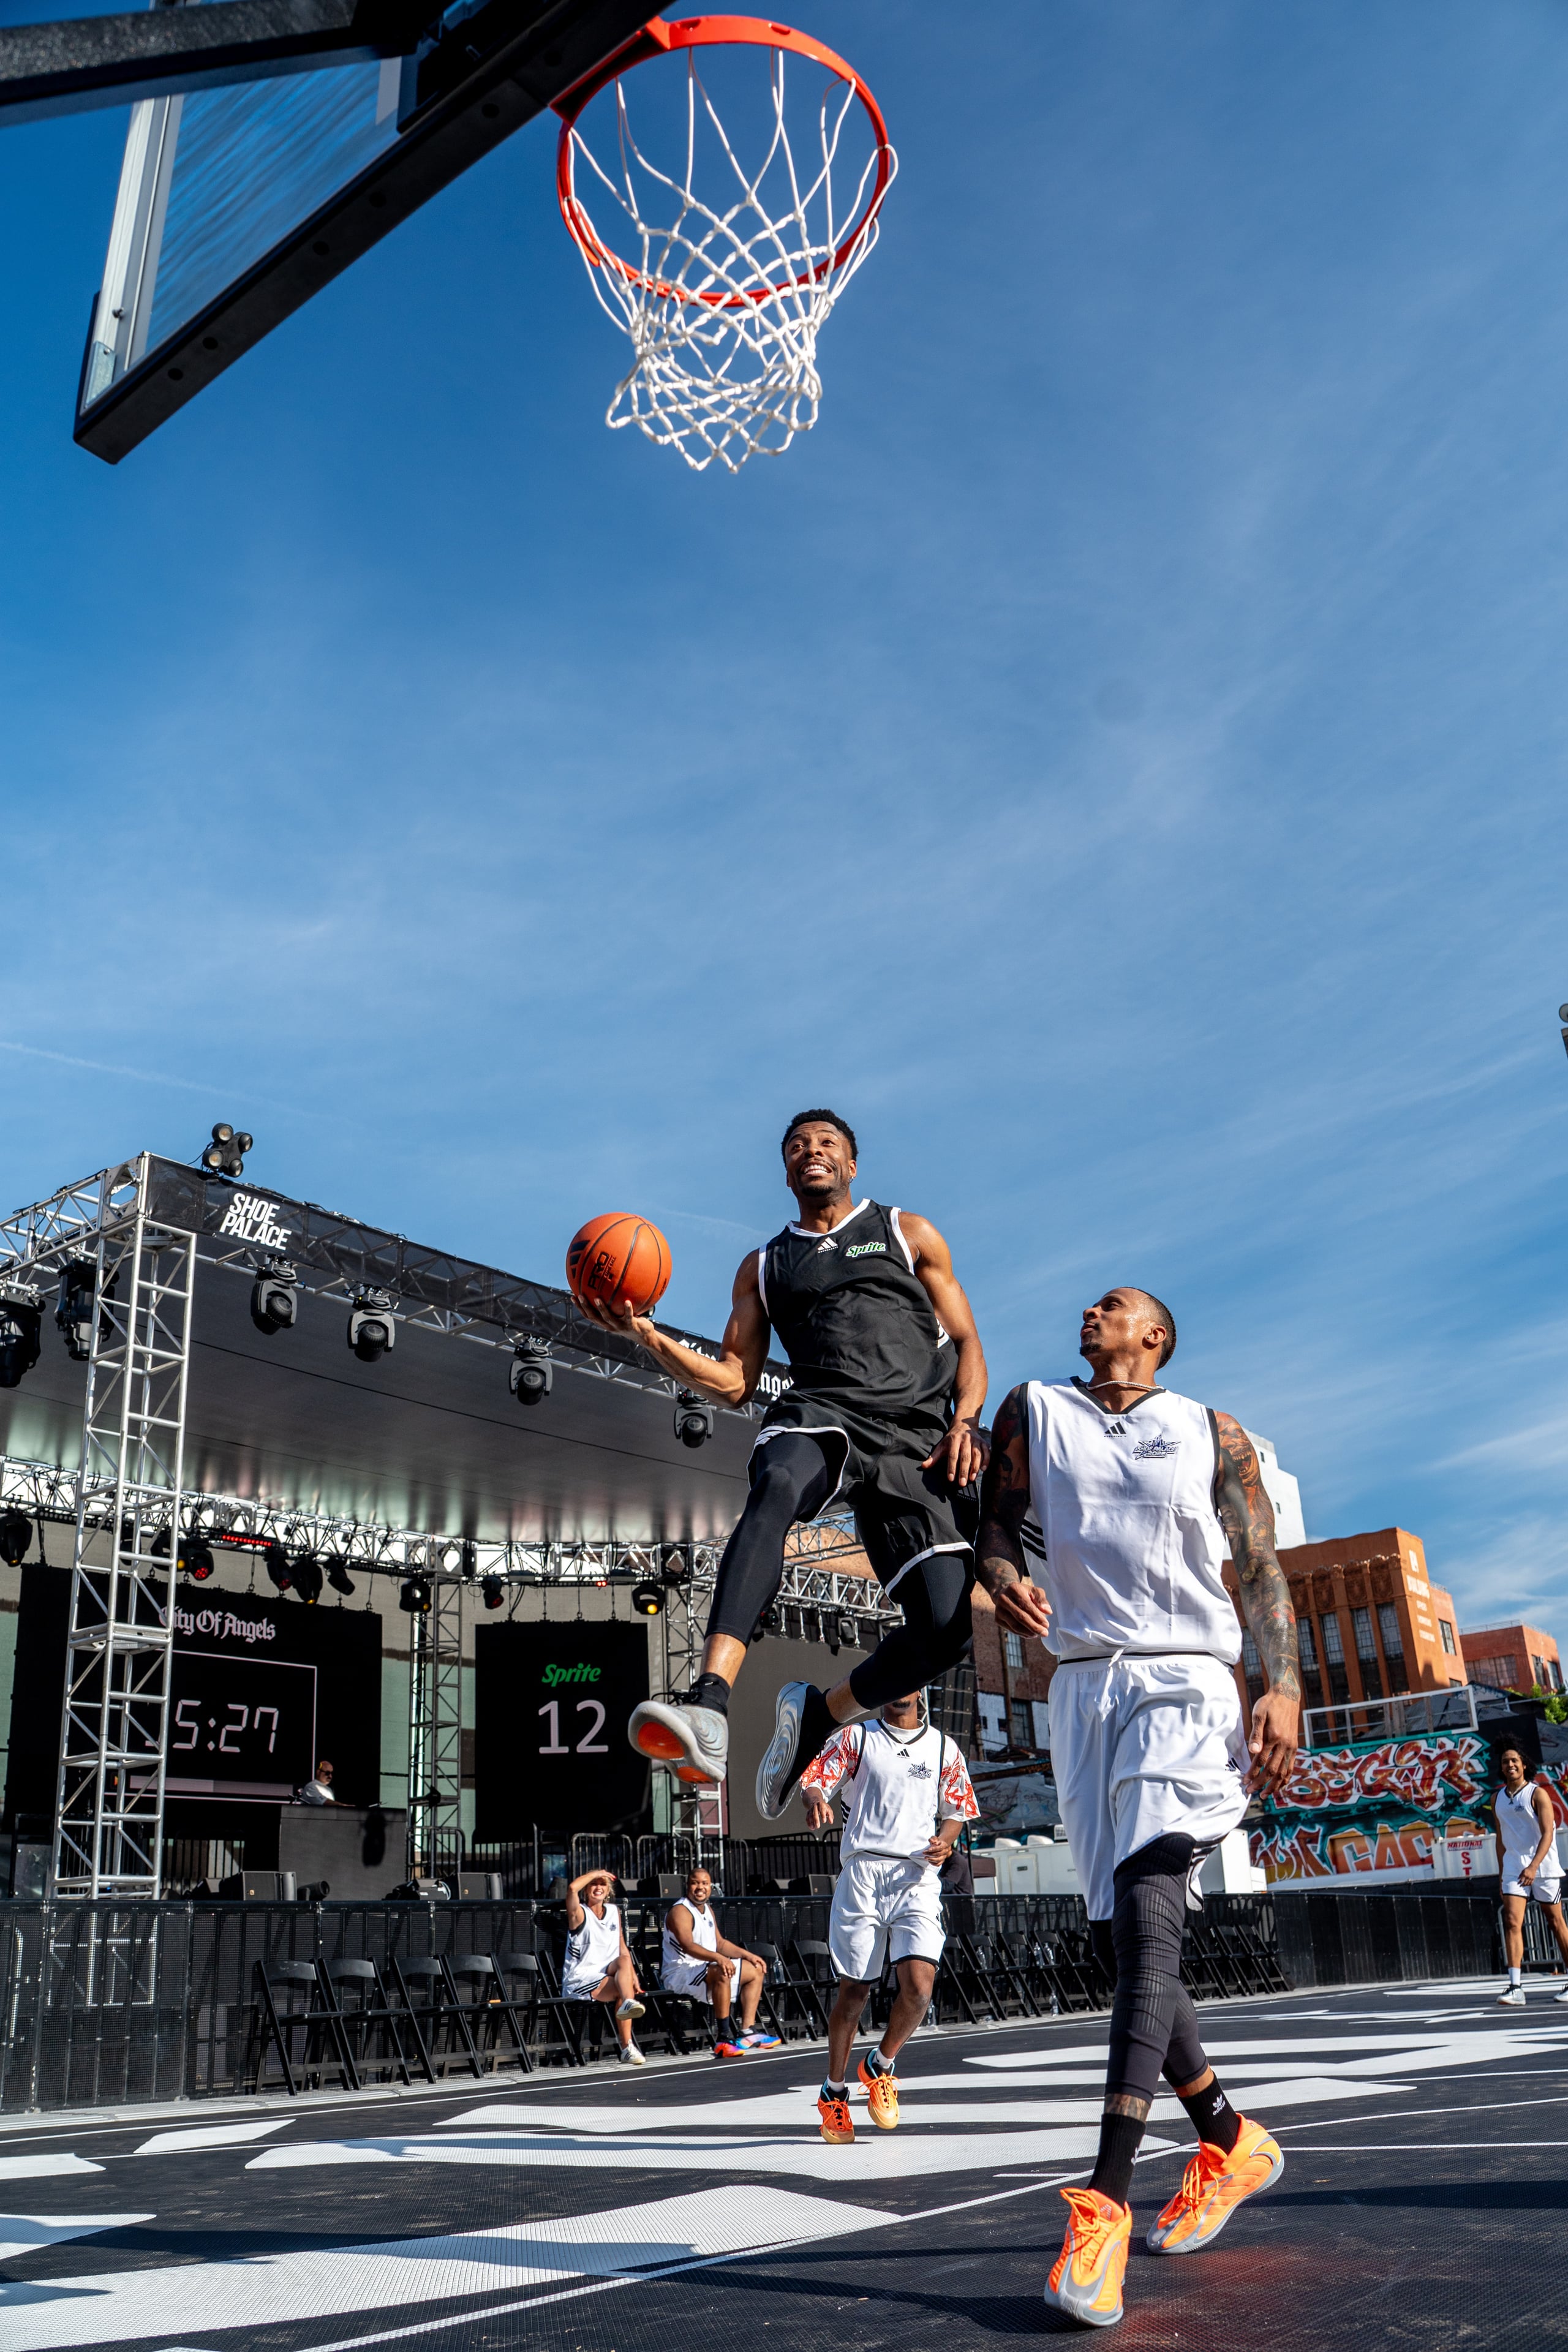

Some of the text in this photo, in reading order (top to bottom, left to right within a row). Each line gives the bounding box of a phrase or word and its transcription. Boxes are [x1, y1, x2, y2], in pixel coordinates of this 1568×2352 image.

[229, 1193, 281, 1226] SHOE
[219, 1212, 292, 1250] PALACE
[846, 1242, 886, 1257] Sprite
[588, 1251, 609, 1289] PRO
[196, 1609, 223, 1637] Of
[221, 1611, 276, 1643] Angels
[541, 1662, 601, 1687] Sprite
[145, 1699, 279, 1753] 5:27
[538, 1700, 609, 1754] 12
[1212, 2100, 1226, 2116] adidas
